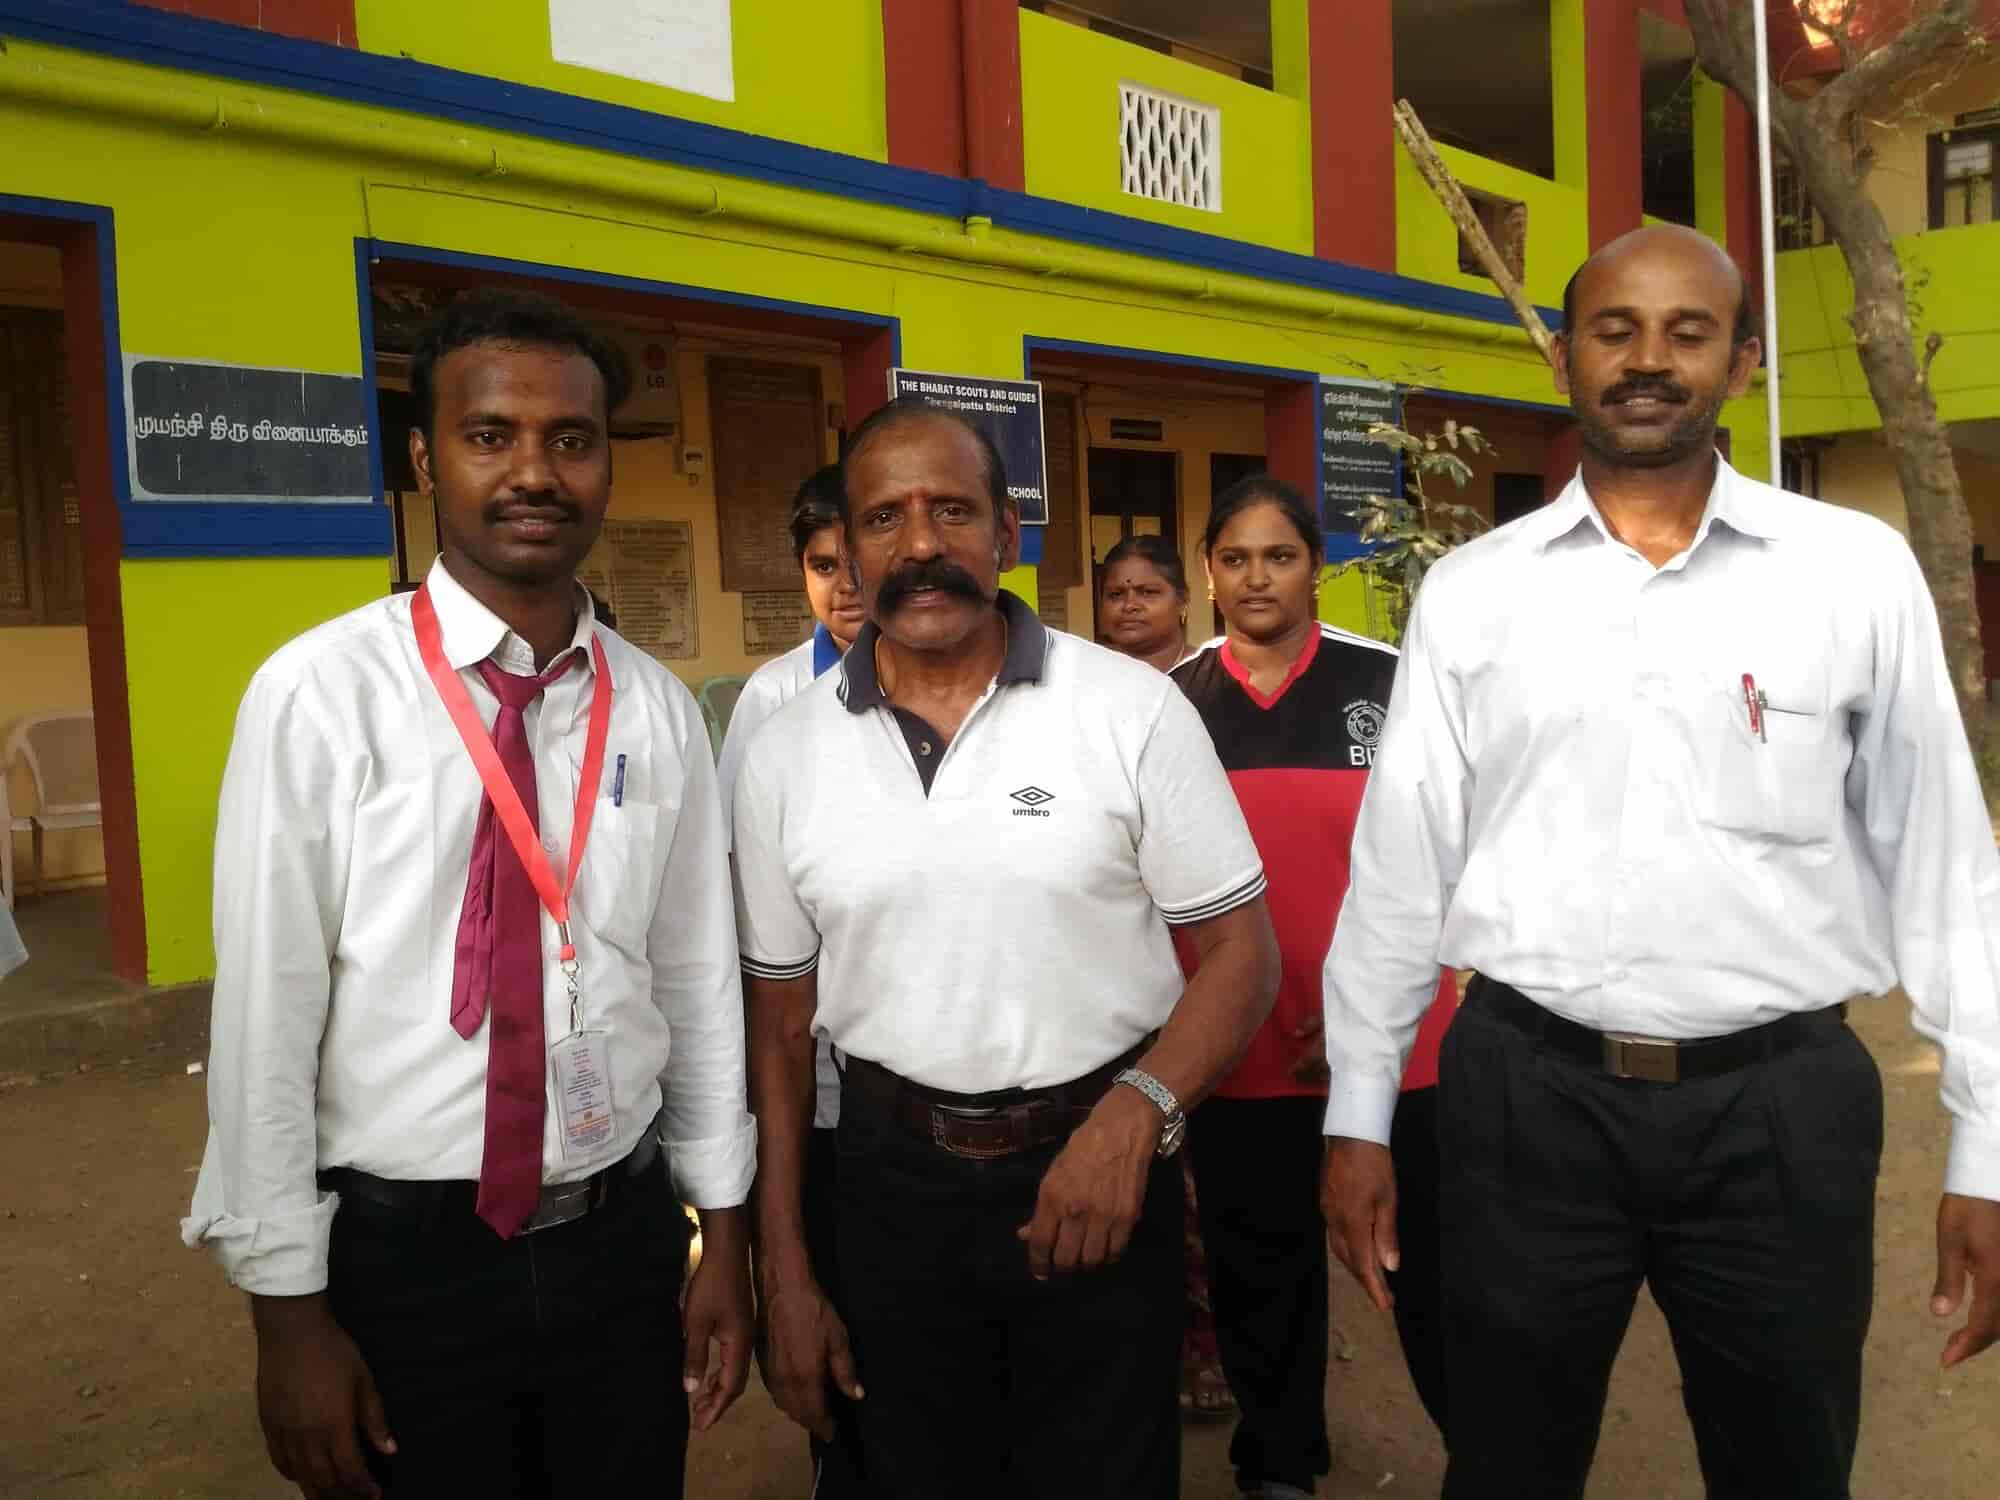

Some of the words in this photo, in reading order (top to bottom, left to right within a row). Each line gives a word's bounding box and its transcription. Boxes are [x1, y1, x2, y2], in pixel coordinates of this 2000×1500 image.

[900, 380, 918, 392] THE
[920, 382, 954, 395] BHARAT
[956, 386, 988, 399] SCOUTS
[990, 389, 1007, 400] AND
[1008, 391, 1036, 403] GUIDES
[986, 402, 1016, 414] District
[210, 415, 248, 442] திரு
[1007, 487, 1042, 499] SCHOOL
[1012, 807, 1050, 817] umbro
